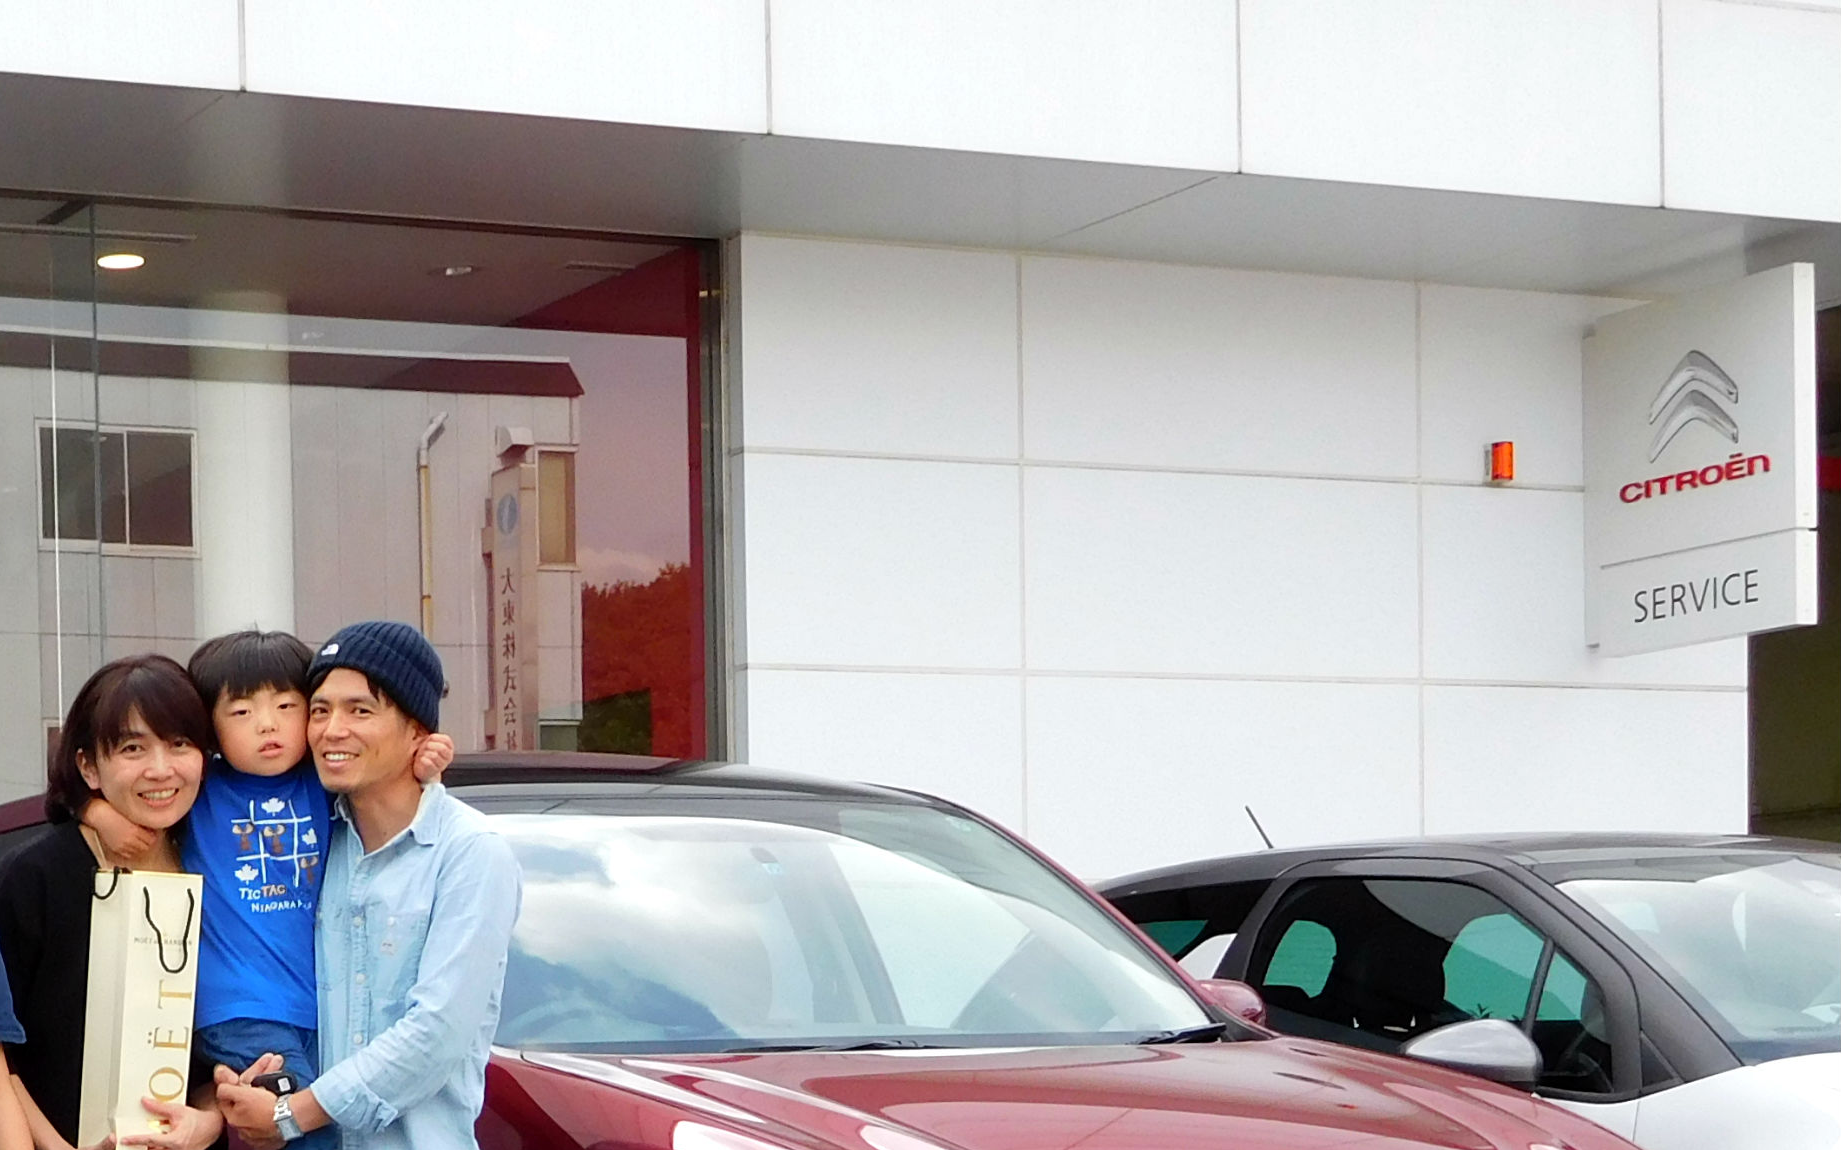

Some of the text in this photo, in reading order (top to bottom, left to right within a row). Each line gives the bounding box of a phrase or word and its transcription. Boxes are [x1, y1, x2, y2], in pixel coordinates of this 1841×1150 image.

[1633, 569, 1759, 623] SERVICE
[239, 887, 261, 900] TIC
[147, 979, 192, 1103] OËT
